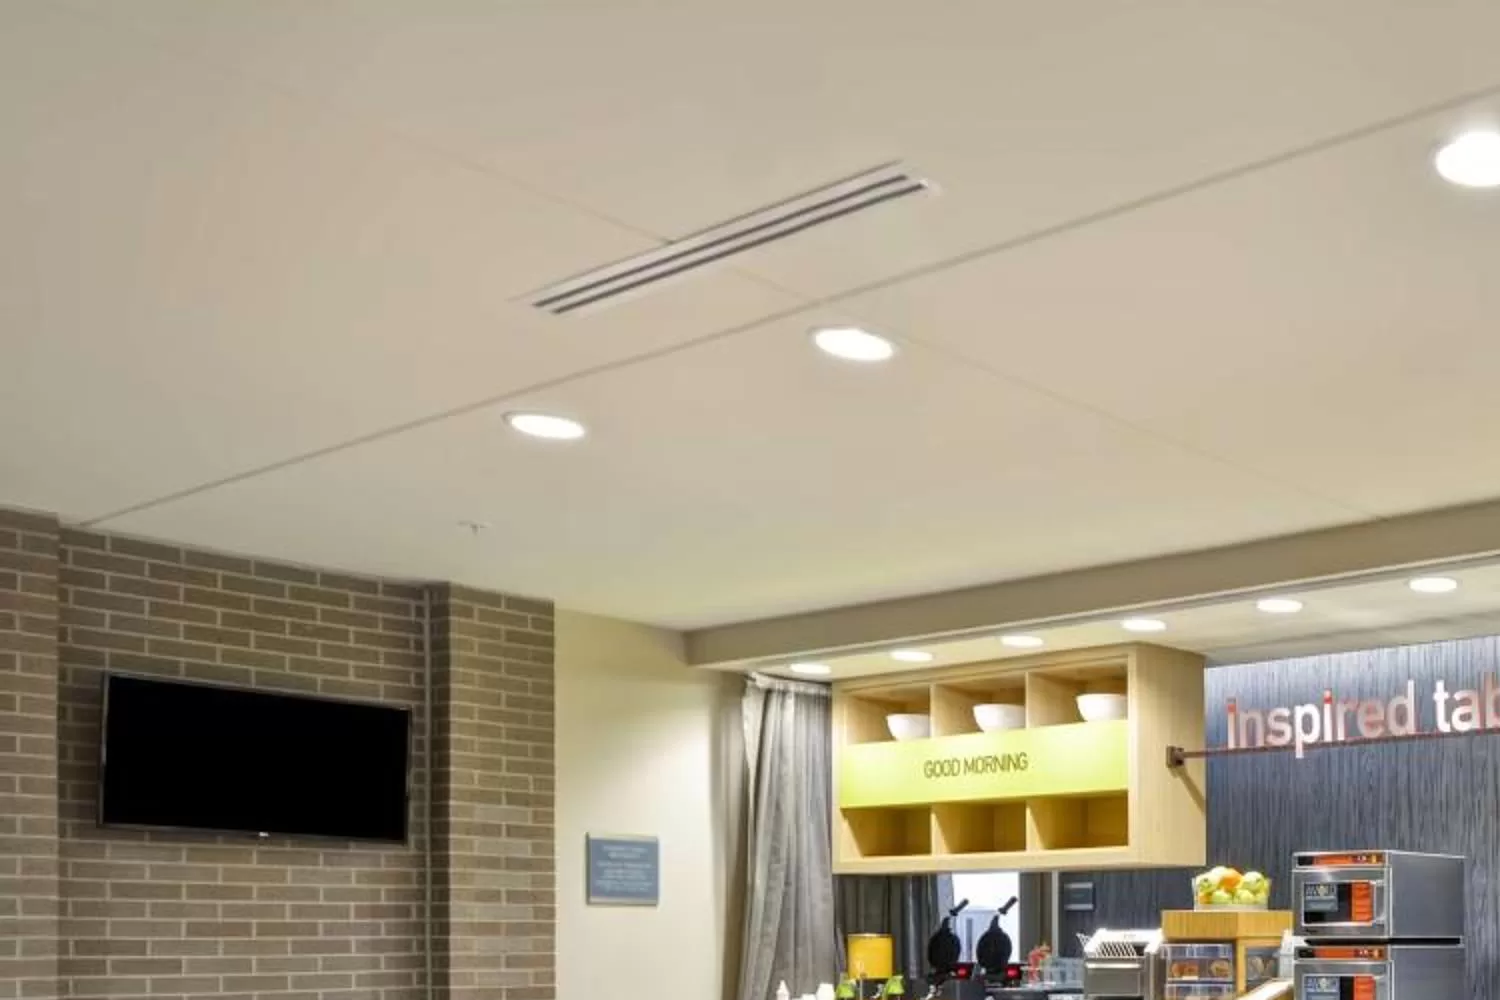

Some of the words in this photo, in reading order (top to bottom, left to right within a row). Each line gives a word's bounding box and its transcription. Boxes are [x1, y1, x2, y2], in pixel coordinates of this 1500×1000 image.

[1227, 679, 1416, 759] inspired
[923, 758, 961, 779] GOOD
[963, 751, 1029, 776] MORNING
